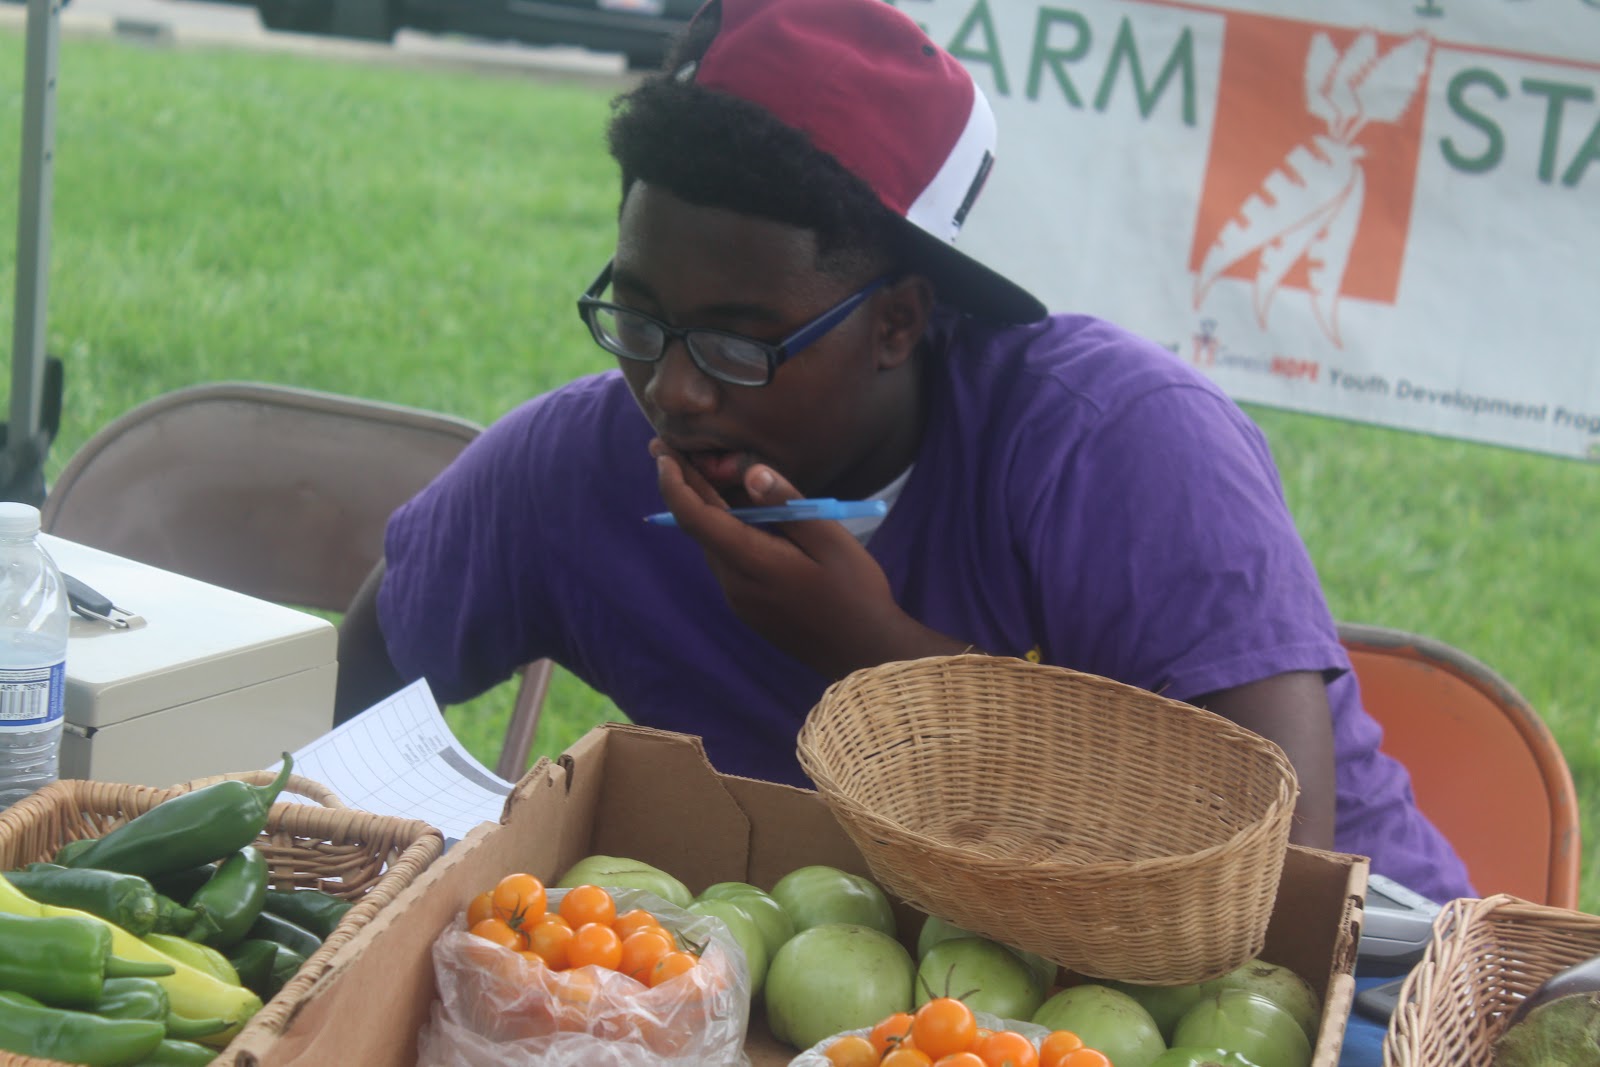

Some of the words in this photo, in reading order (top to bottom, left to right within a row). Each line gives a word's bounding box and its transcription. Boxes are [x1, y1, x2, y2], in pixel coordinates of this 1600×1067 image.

[915, 0, 1197, 126] ARM
[1329, 367, 1390, 396] Youth
[1396, 379, 1547, 421] Development
